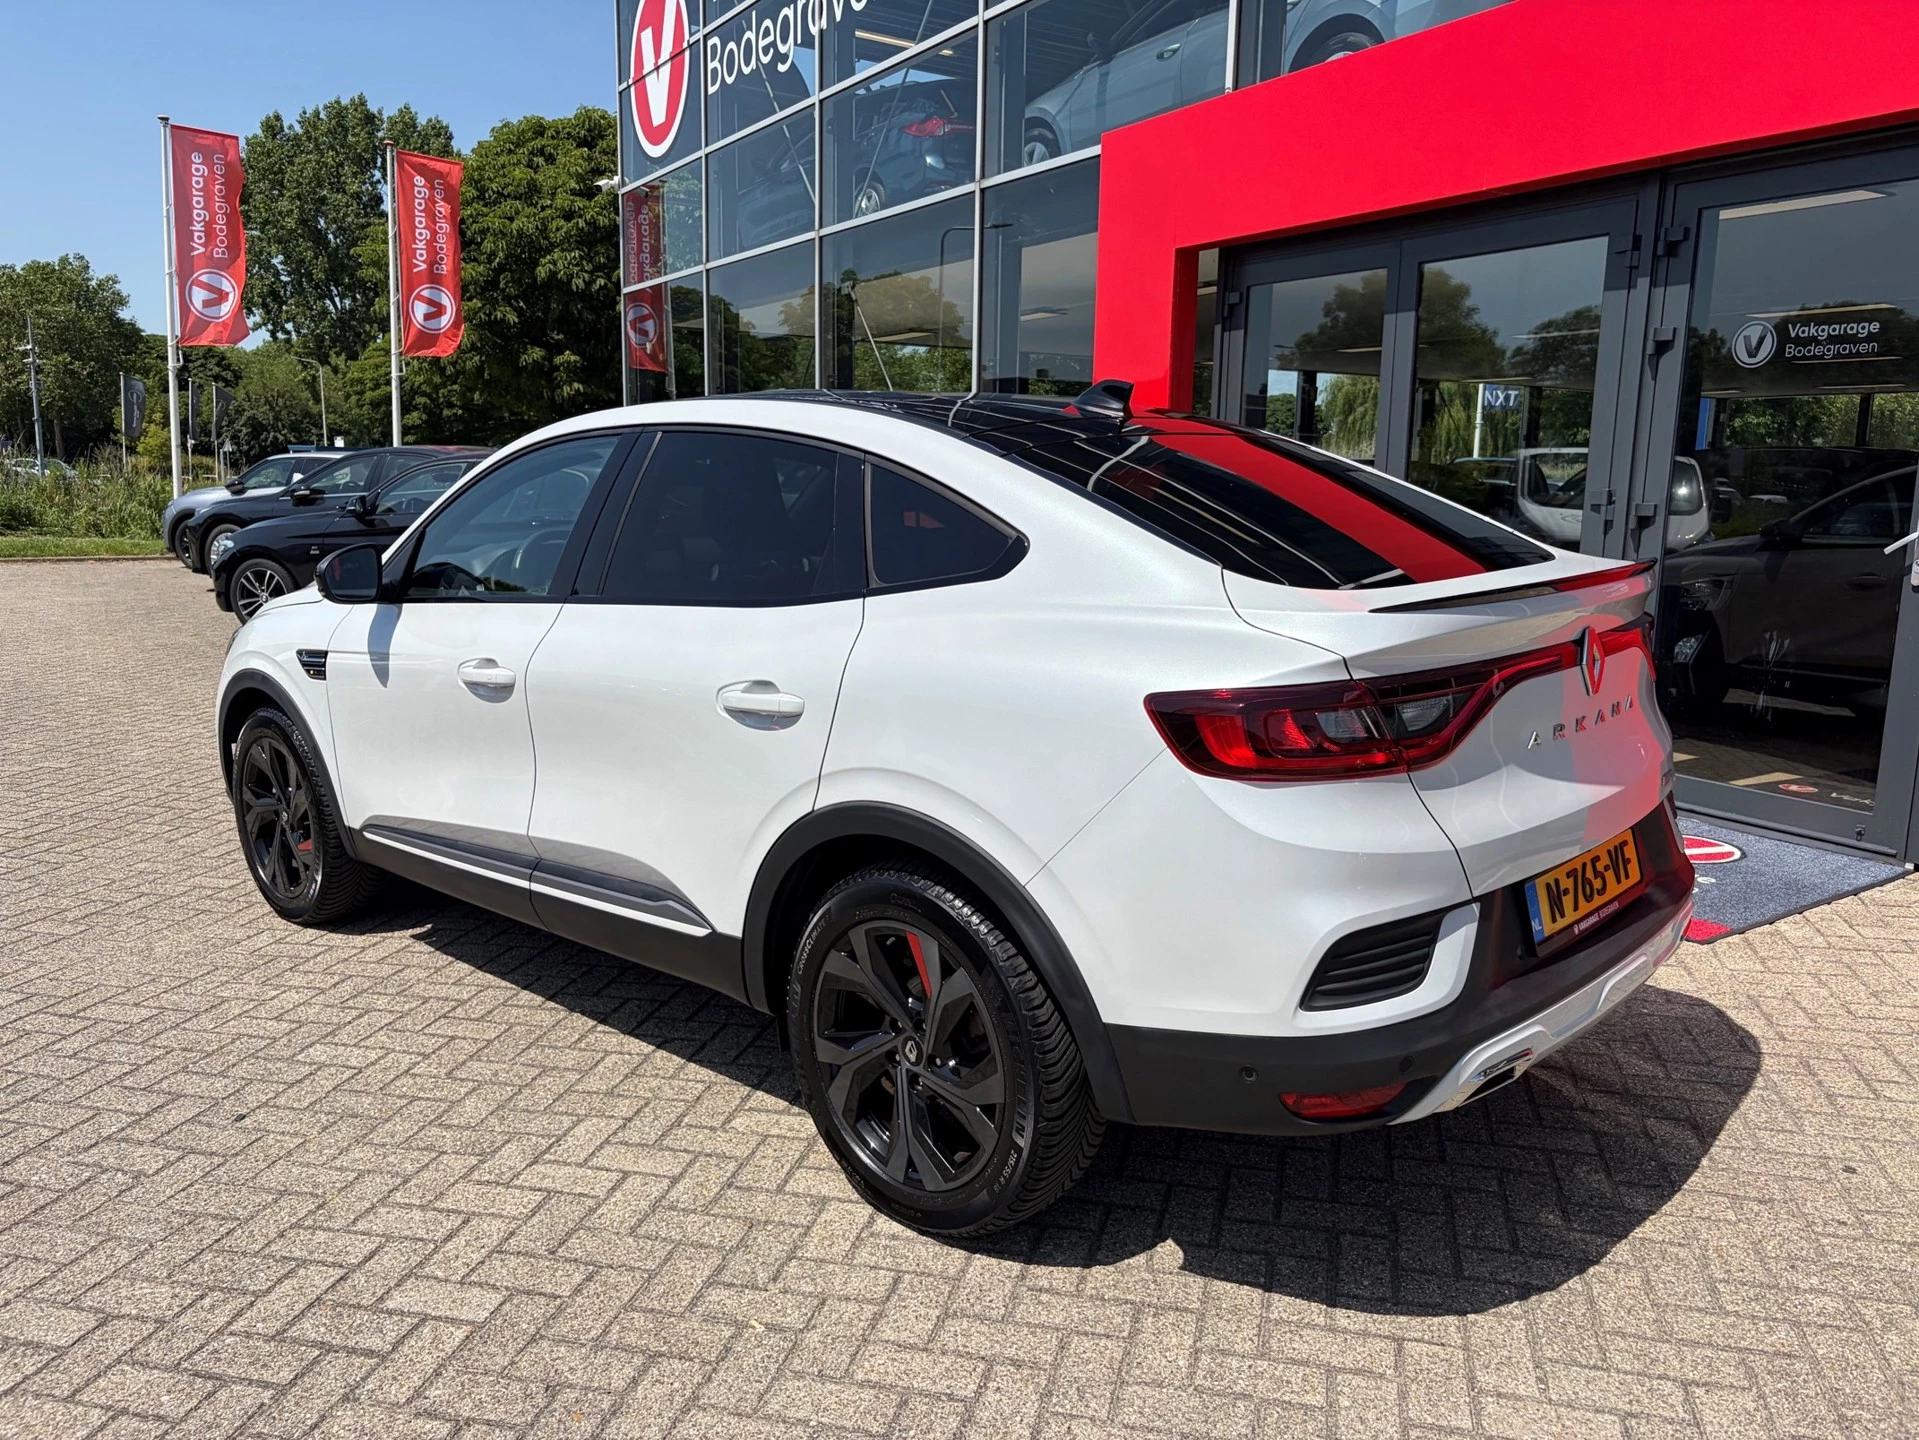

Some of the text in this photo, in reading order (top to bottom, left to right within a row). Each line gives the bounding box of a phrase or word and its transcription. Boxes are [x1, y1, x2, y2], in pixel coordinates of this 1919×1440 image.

[189, 151, 209, 256] Vakgarage
[212, 154, 230, 258] Bodegraven
[412, 175, 430, 272] Vakgarage
[433, 179, 450, 274] Bodegraven
[1785, 342, 1878, 359] Bodegraven
[1787, 321, 1880, 340] Vakgarage
[1483, 390, 1519, 407] NXT
[1527, 695, 1634, 750] ARKANA
[1545, 839, 1632, 925] N-765-VF
[1531, 918, 1542, 933] NL
